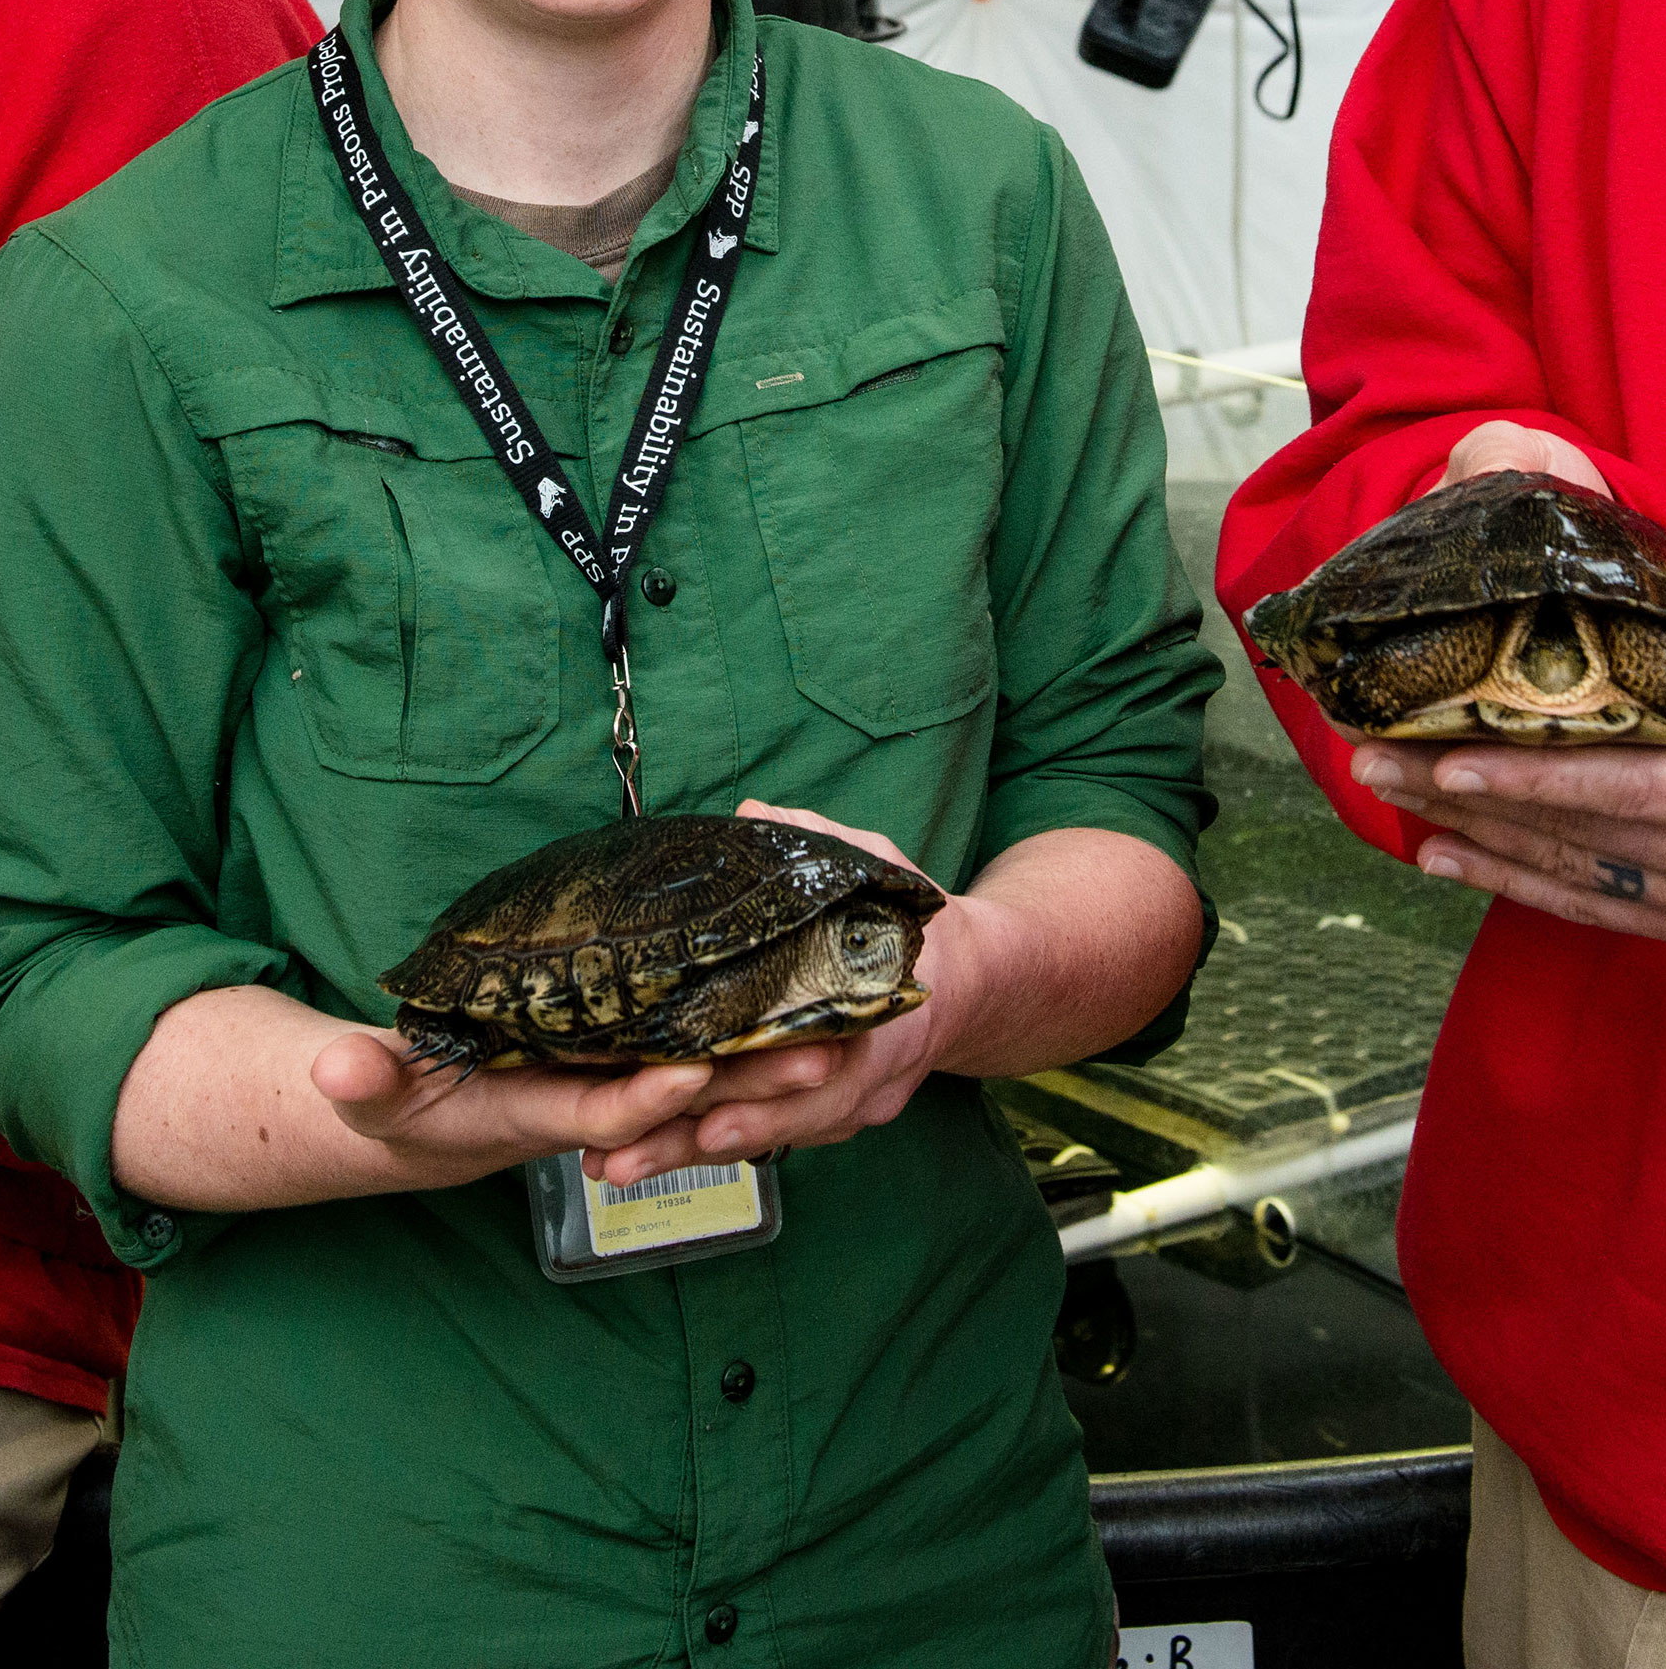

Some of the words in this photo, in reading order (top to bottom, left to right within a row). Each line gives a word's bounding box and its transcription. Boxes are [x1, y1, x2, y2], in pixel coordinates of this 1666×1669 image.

[332, 103, 390, 212] Prisons
[724, 161, 751, 219] SPP
[379, 201, 410, 245] in
[399, 245, 535, 466] Sustainability
[622, 277, 722, 498] Sustainability
[613, 503, 649, 536] in
[560, 530, 605, 584] SPP
